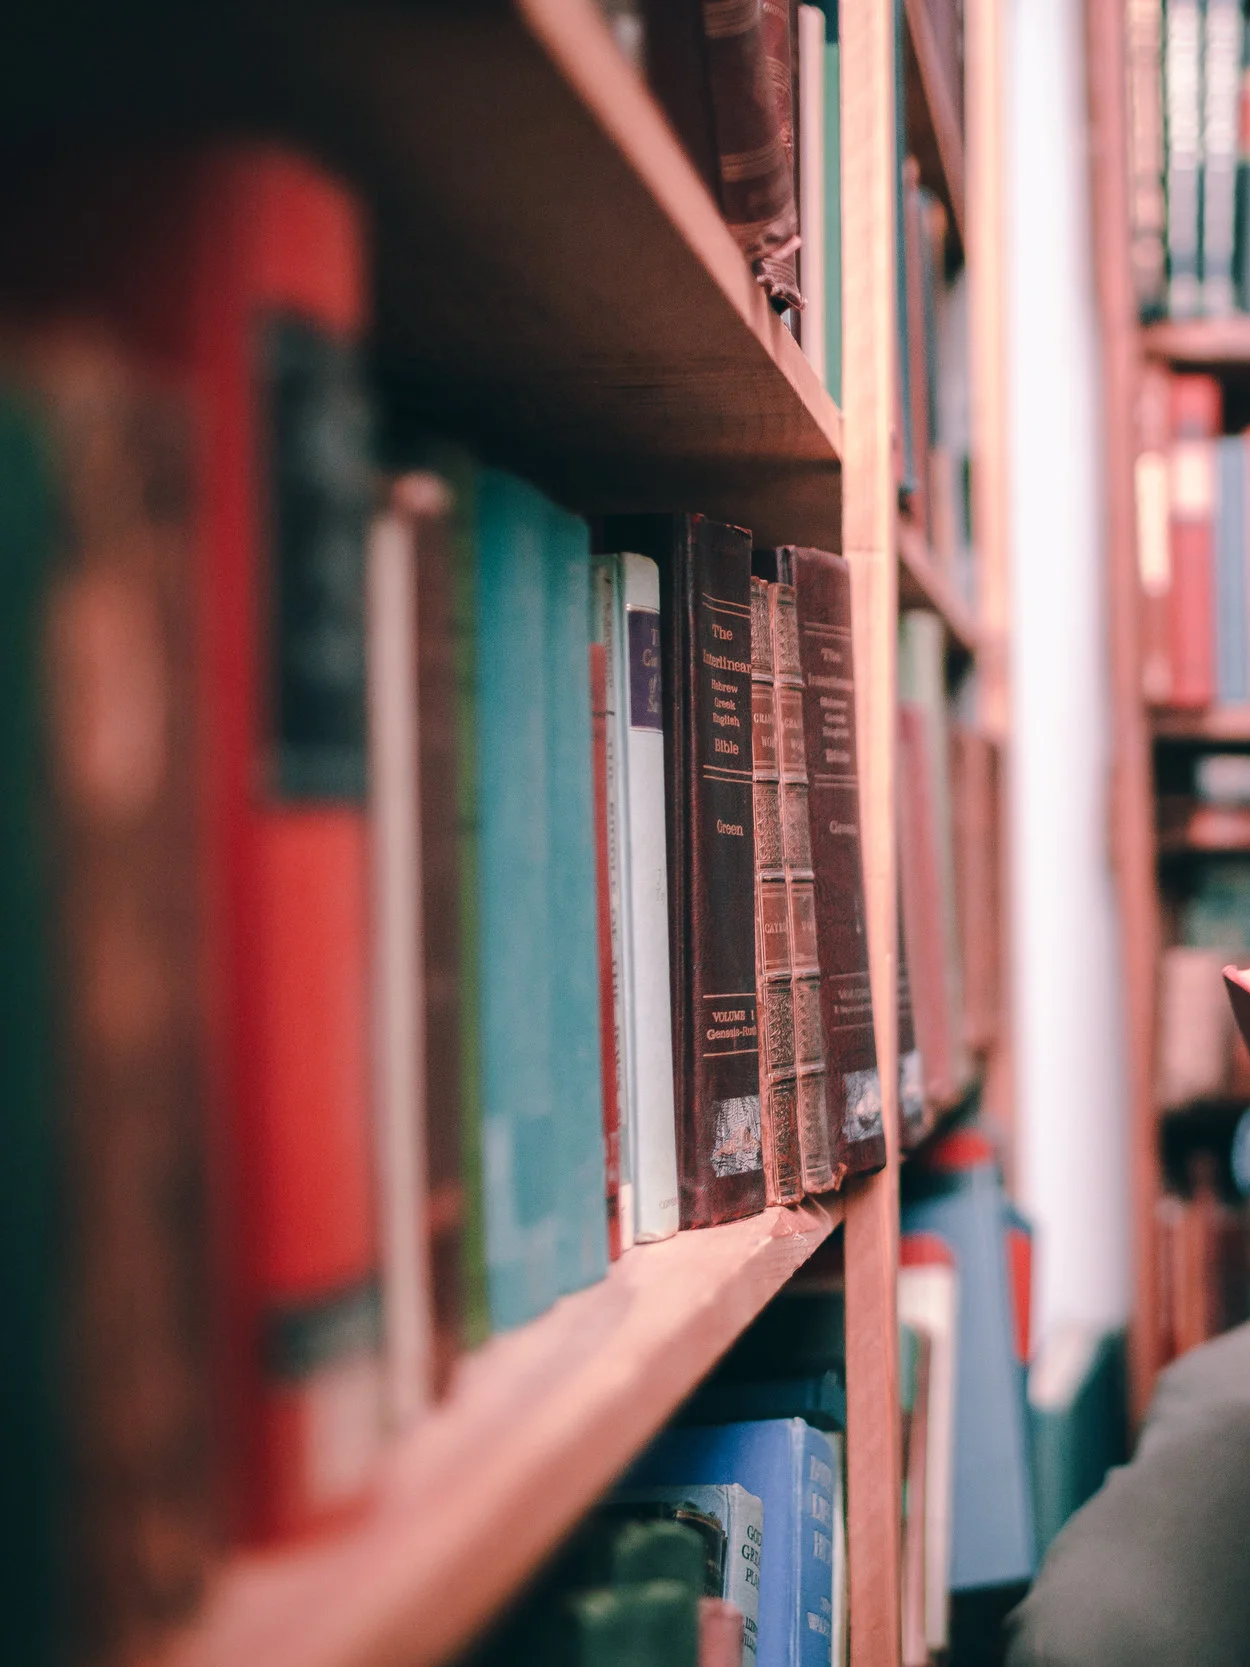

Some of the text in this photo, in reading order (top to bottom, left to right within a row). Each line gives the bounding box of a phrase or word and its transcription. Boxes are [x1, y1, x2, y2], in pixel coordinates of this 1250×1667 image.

[712, 623, 733, 641] The
[702, 648, 752, 675] Interlinear
[711, 678, 738, 694] Hebrew
[714, 697, 736, 711] Greek
[712, 712, 740, 728] English
[714, 737, 739, 756] Bible
[716, 818, 744, 837] Green
[711, 1010, 746, 1023] VOLUME
